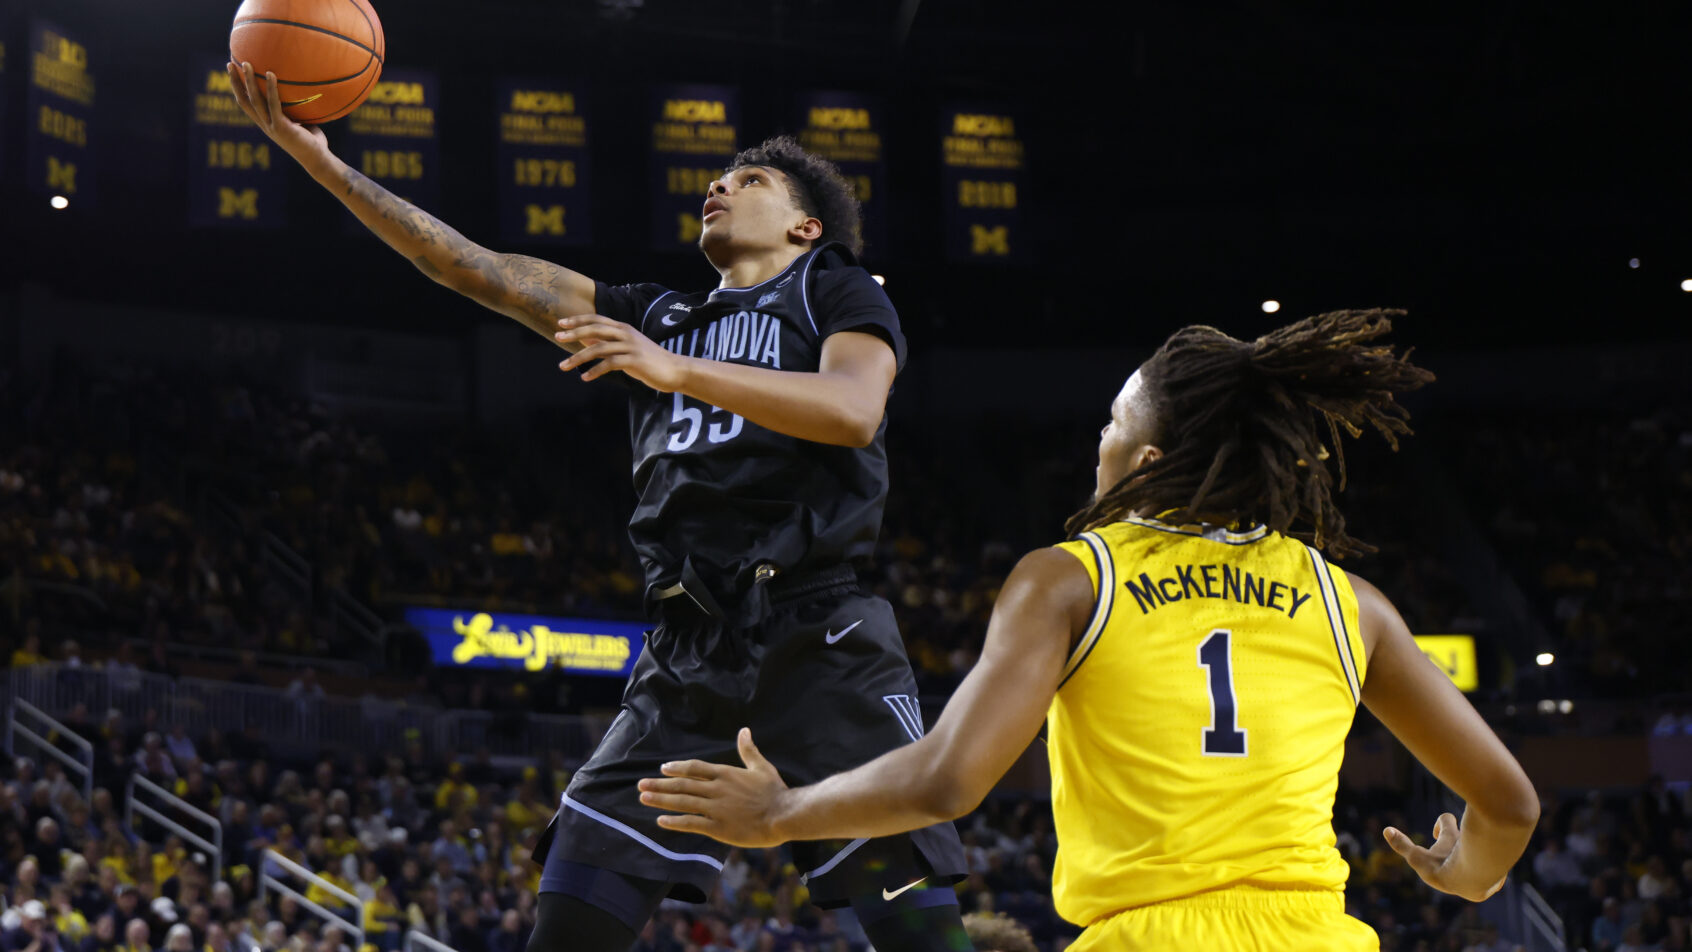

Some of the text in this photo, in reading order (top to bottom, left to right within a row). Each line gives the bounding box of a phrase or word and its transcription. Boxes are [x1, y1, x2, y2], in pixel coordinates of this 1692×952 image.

[208, 141, 270, 170] 1964
[362, 150, 424, 179] 1965
[515, 158, 576, 187] 1976
[1124, 563, 1311, 619] McKENNEY
[1197, 628, 1248, 758] 1
